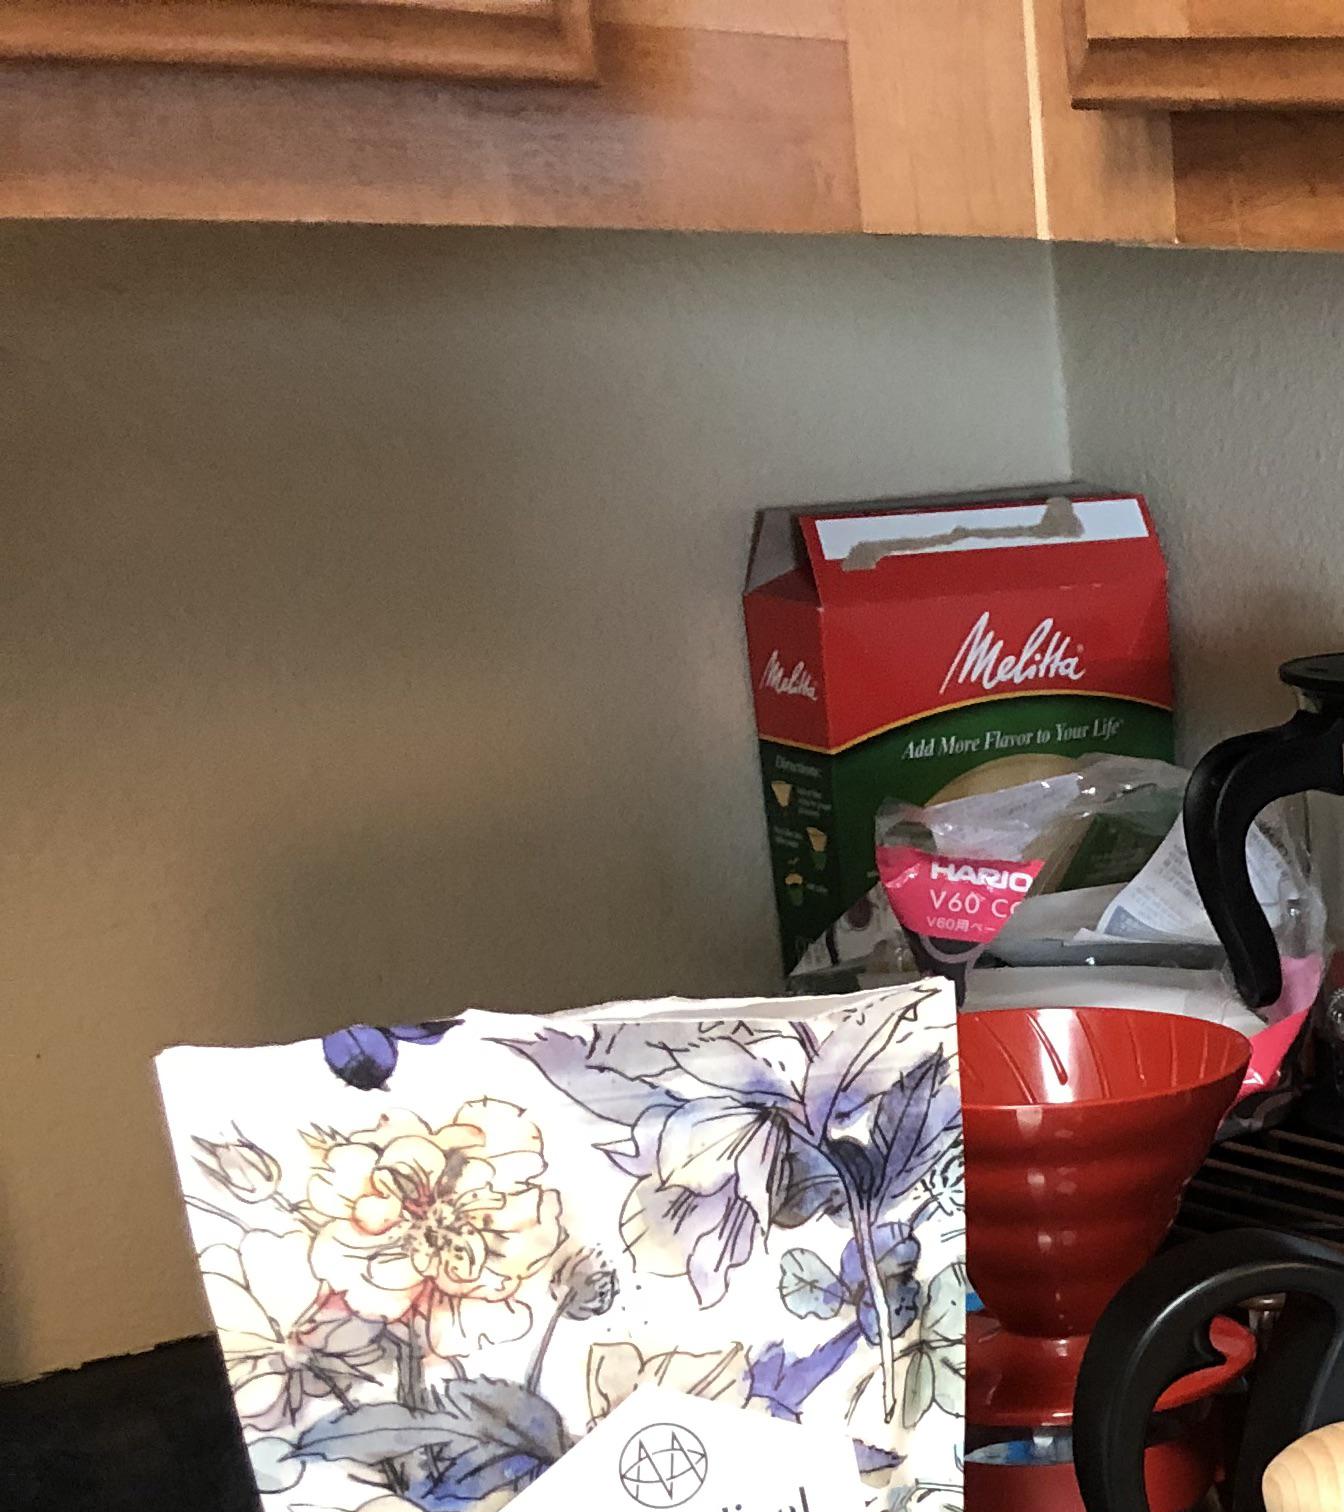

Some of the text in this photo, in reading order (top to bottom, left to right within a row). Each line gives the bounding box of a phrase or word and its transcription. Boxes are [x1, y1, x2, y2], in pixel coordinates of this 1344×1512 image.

[939, 611, 1085, 695] Melitta
[760, 650, 817, 700] Melitta
[902, 718, 1120, 760] Add More Flavor to Your Life
[931, 862, 1033, 892] HARIO
[930, 889, 981, 914] V60
